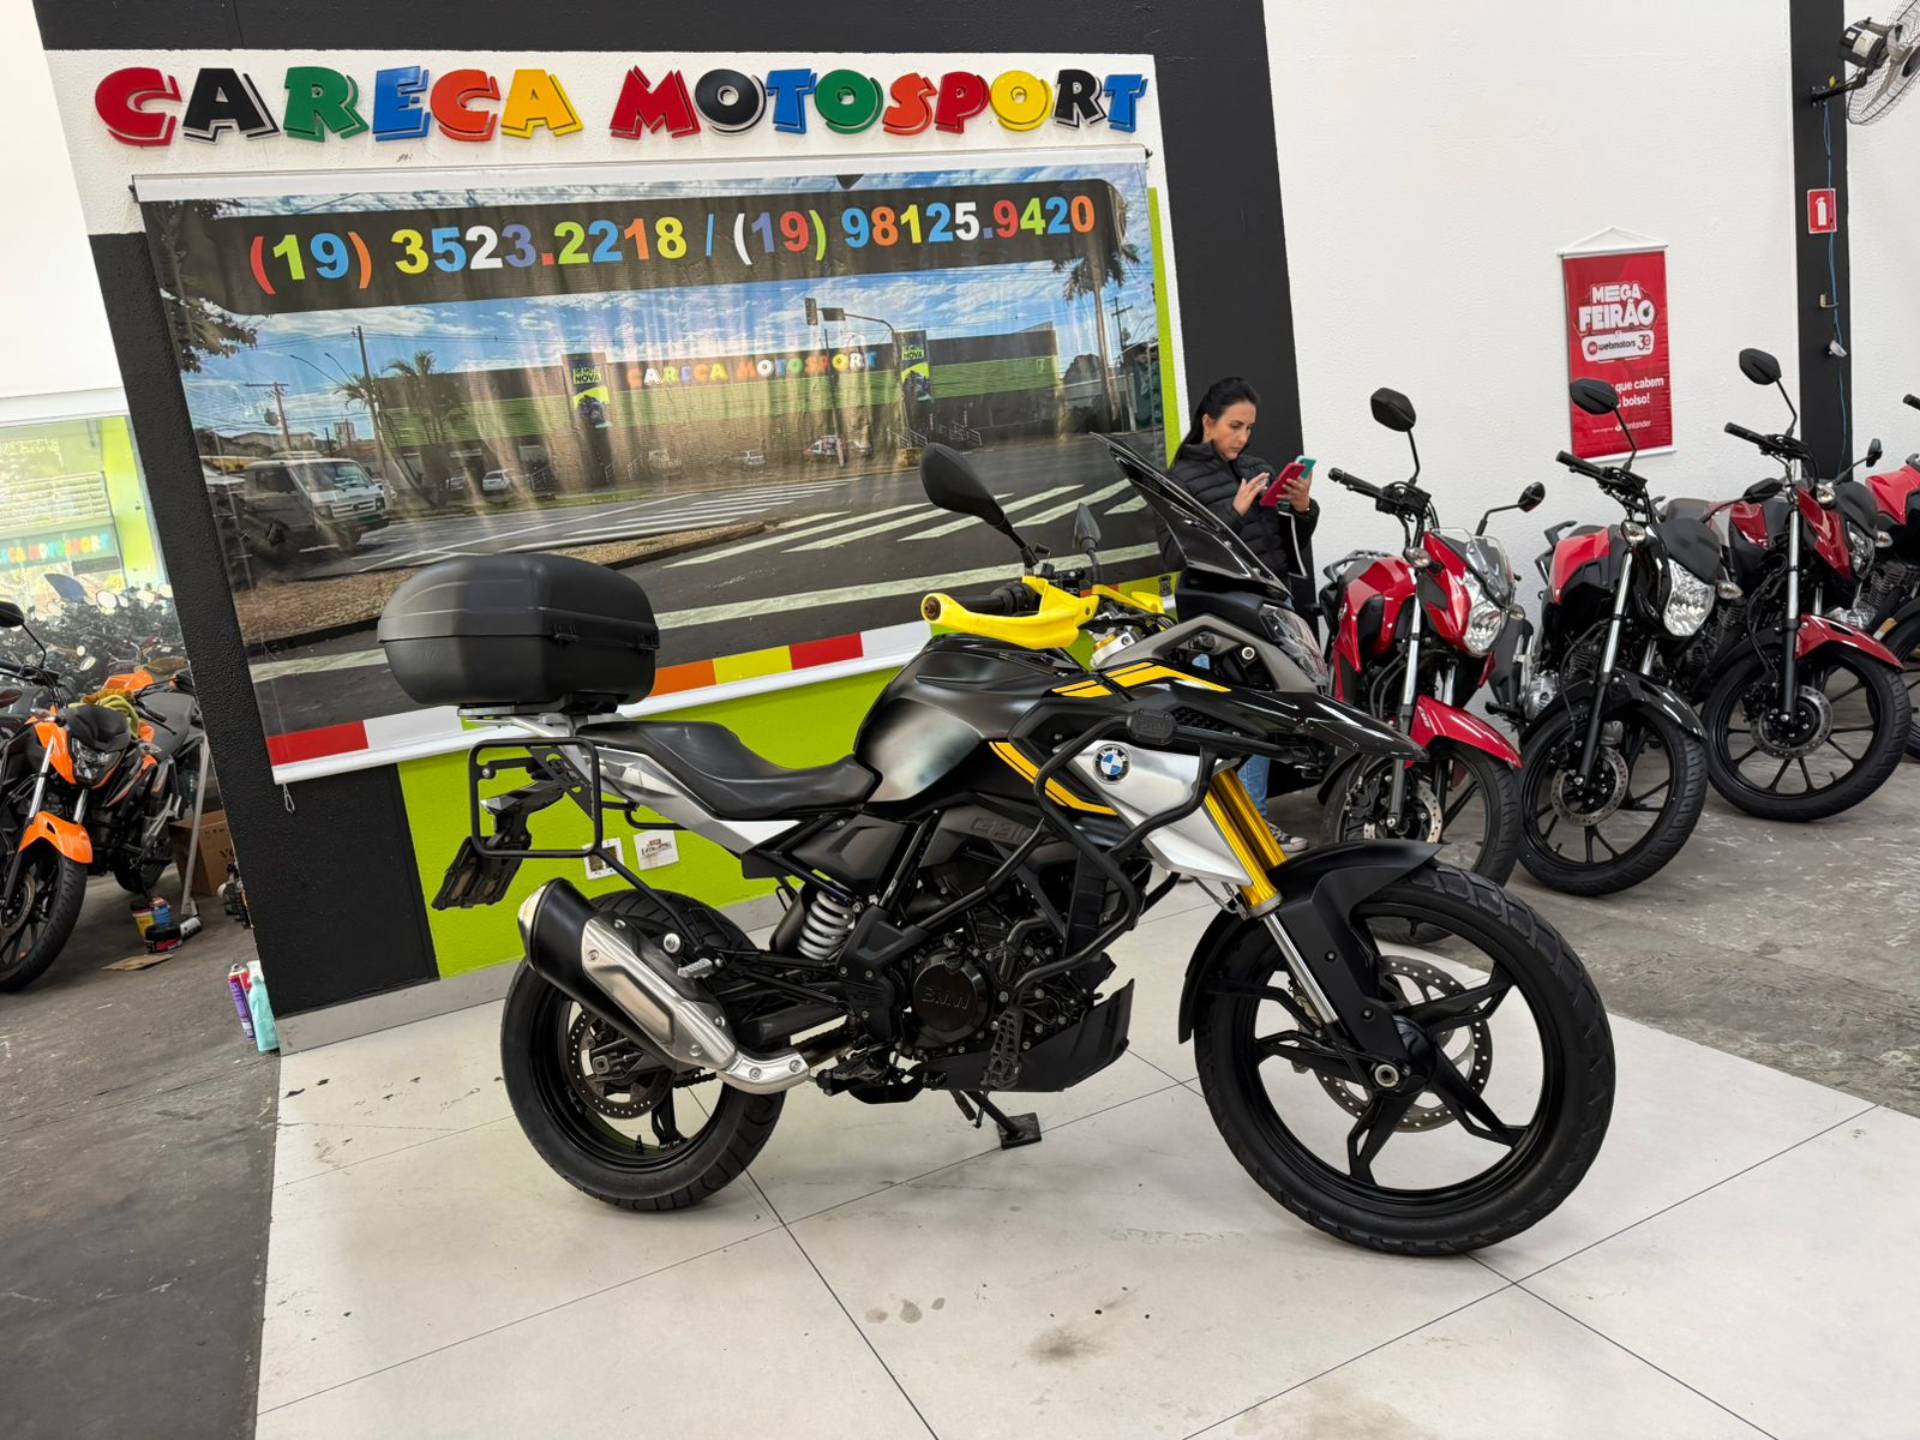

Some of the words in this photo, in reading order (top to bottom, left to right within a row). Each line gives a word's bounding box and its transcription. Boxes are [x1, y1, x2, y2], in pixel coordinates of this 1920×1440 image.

[95, 65, 584, 147] CARECA
[609, 65, 1148, 140] MOTOSPORT
[250, 232, 372, 295] (19)
[391, 216, 688, 275] 3523.2218
[705, 213, 715, 257] /
[733, 209, 827, 266] (19)
[841, 195, 1096, 249] 98125.9420
[1592, 283, 1641, 303] MEGA
[1578, 299, 1655, 332] FEIRÃO
[1598, 340, 1636, 351] webmotors
[627, 362, 729, 387] CARECA
[1614, 381, 1633, 394] que
[1634, 376, 1664, 390] cabem
[1622, 393, 1651, 407] bolso!
